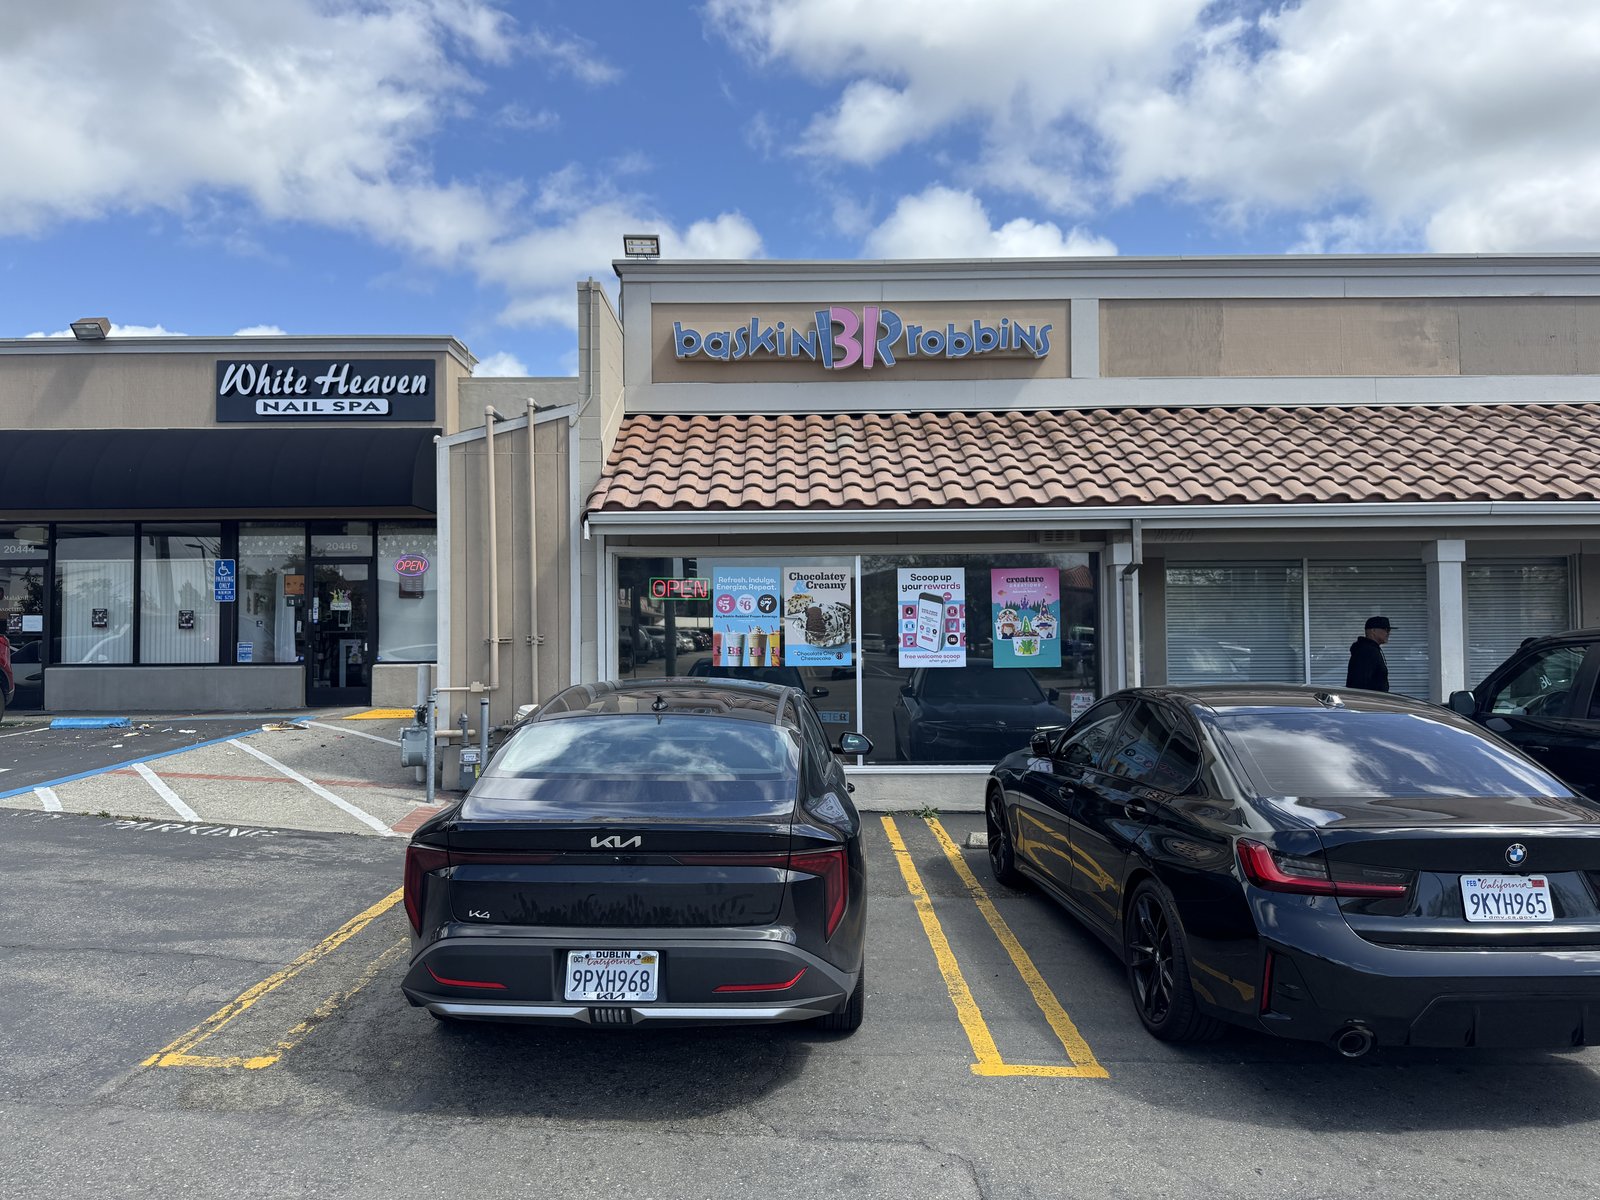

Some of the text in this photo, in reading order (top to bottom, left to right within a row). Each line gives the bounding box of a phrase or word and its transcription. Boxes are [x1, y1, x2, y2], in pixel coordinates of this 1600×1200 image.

[672, 306, 1053, 369] baskin BR robbins
[220, 363, 427, 395] White Heaven
[262, 401, 381, 412] NAIL SPA
[3, 545, 35, 554] 20444
[326, 542, 358, 551] 20446
[396, 560, 425, 571] OPEN
[788, 571, 846, 582] Chocolatey
[910, 573, 952, 582] Scoop up
[652, 580, 708, 598] OPEN
[806, 581, 847, 591] Creamy
[902, 582, 961, 592] your rewards
[718, 600, 730, 611] $5
[740, 600, 751, 611] $6
[760, 600, 772, 611] $7
[590, 835, 642, 848] KIA
[1480, 879, 1527, 892] California
[1470, 893, 1547, 915] 9KYH965
[468, 910, 490, 919] K4
[571, 969, 650, 993] 9PXH968
[596, 992, 626, 1000] KIA
